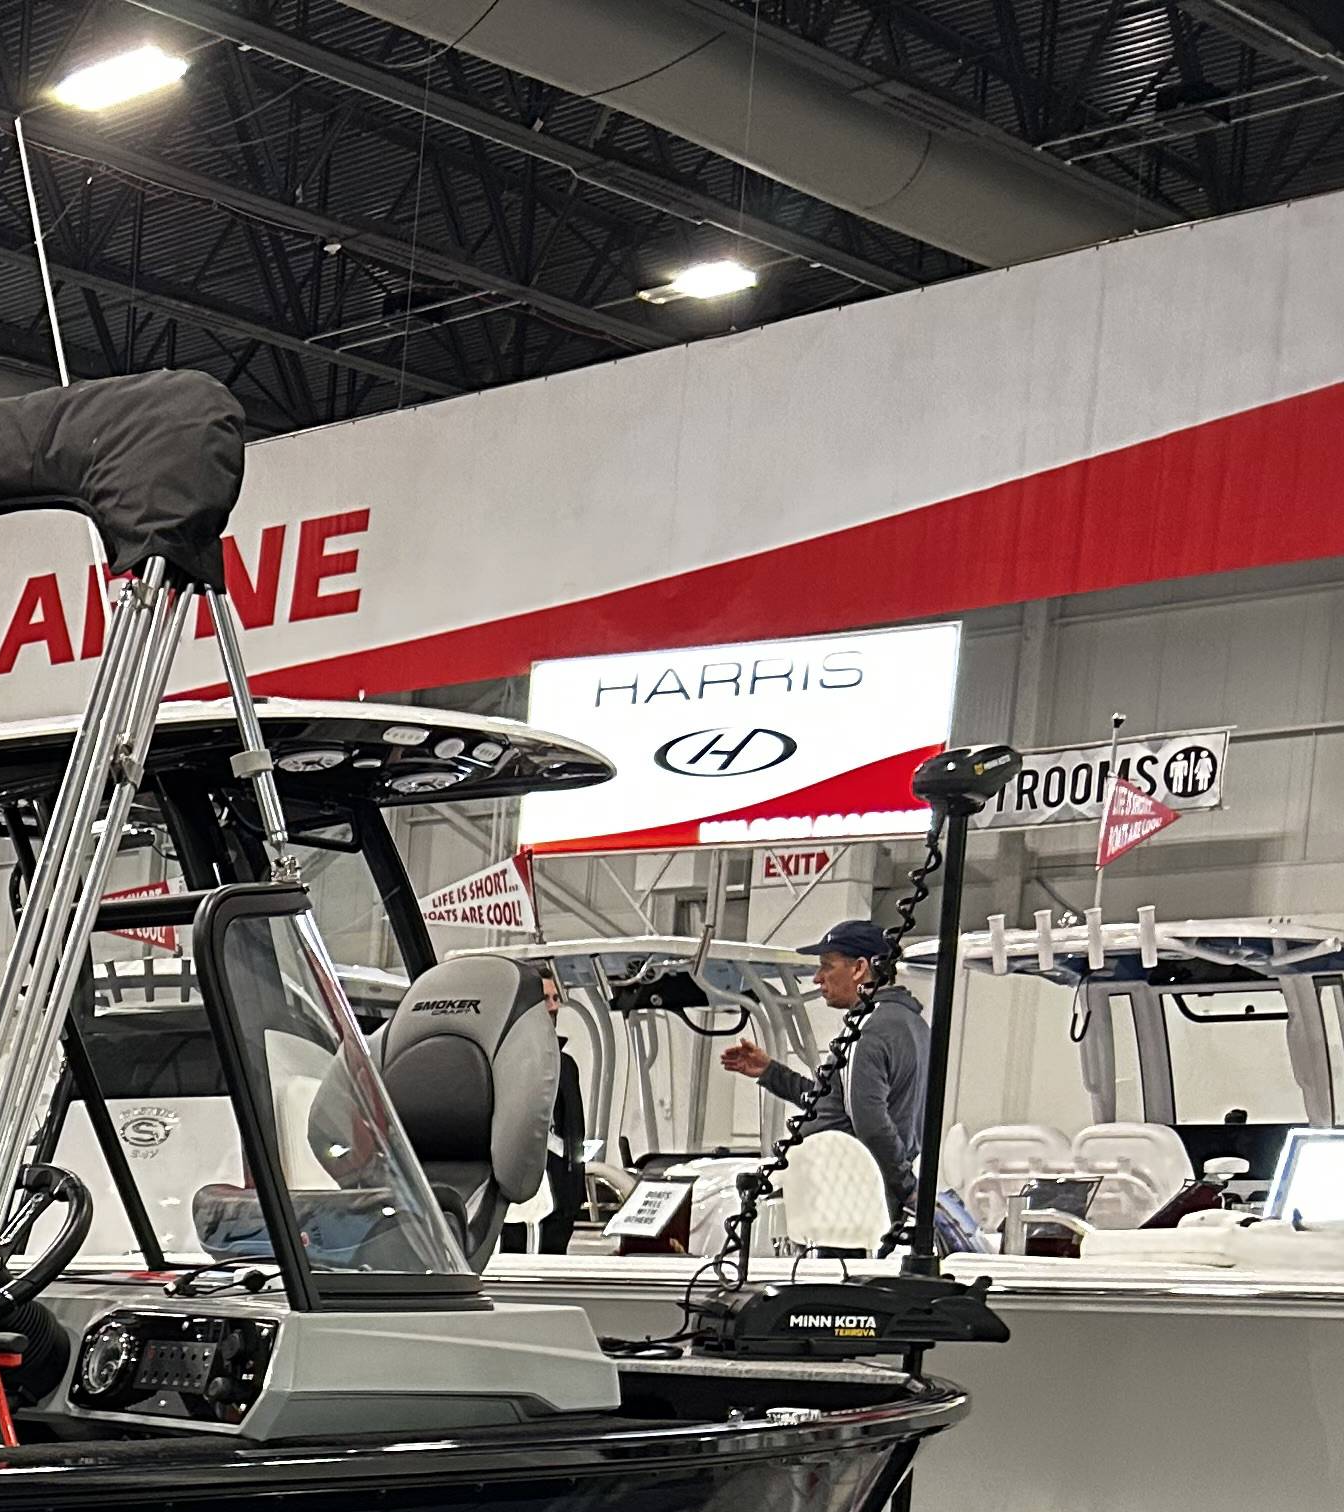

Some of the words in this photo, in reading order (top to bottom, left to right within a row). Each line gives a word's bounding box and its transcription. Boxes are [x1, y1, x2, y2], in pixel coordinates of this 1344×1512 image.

[593, 650, 865, 707] HARRIS
[764, 853, 816, 879] EXIT
[432, 891, 455, 909] LIFE
[457, 885, 468, 903] IS
[461, 905, 485, 924] ARE
[486, 900, 524, 927] COOL!
[411, 999, 480, 1014] SMOKER
[789, 1314, 832, 1328] MINN
[834, 1315, 877, 1328] KOTA
